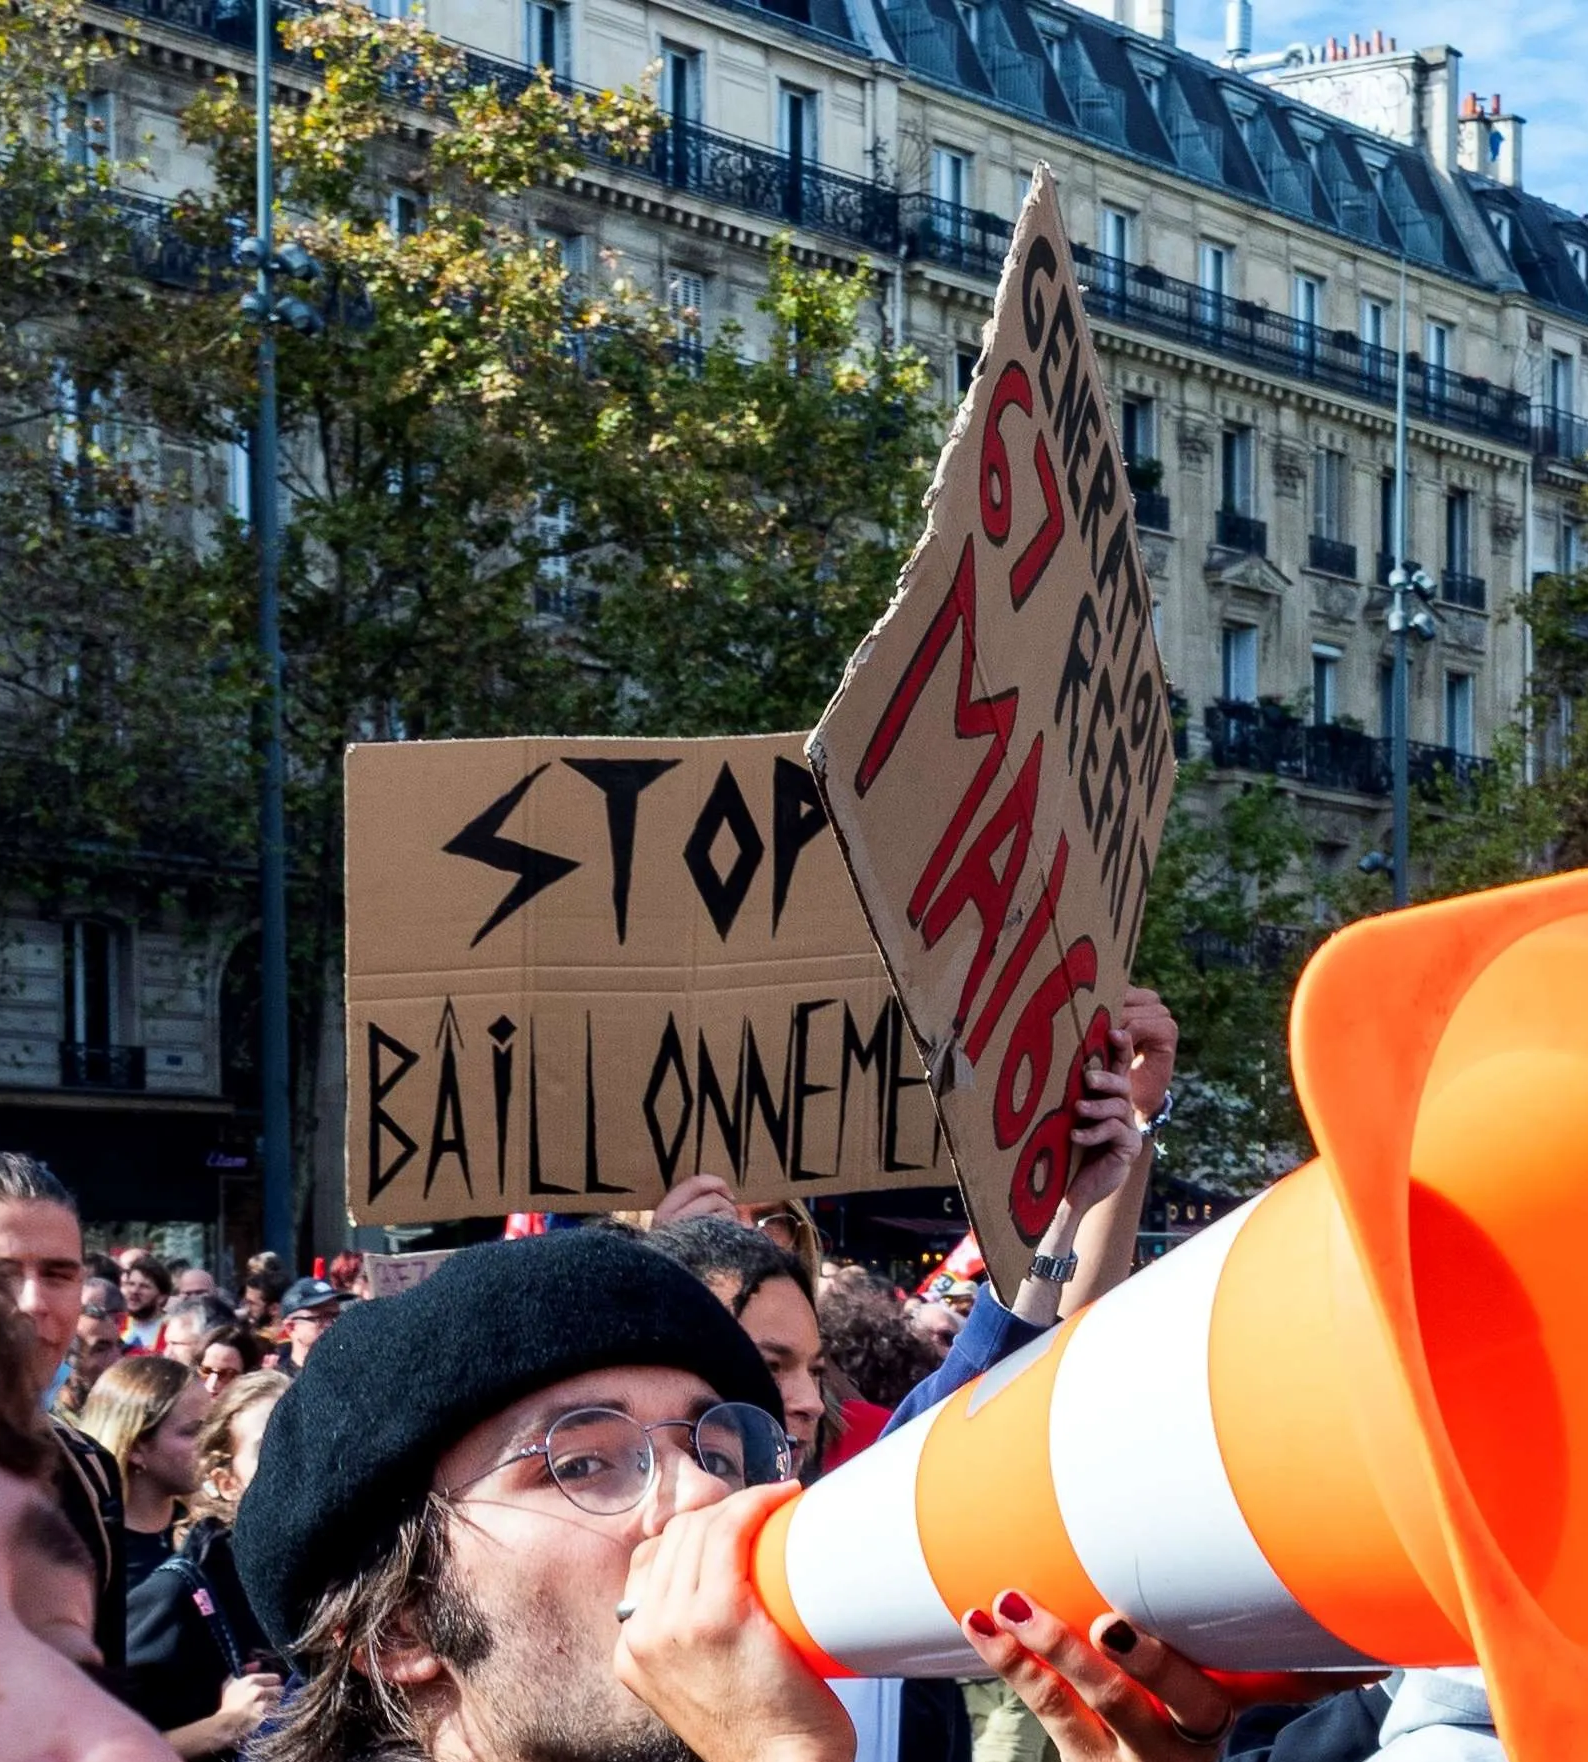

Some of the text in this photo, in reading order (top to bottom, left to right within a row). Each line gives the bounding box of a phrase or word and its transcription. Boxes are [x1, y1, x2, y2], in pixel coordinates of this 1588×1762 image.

[1022, 235, 1169, 818] GENERATION
[441, 756, 832, 949] STOP
[366, 993, 940, 1206] BÂILLONNEME
